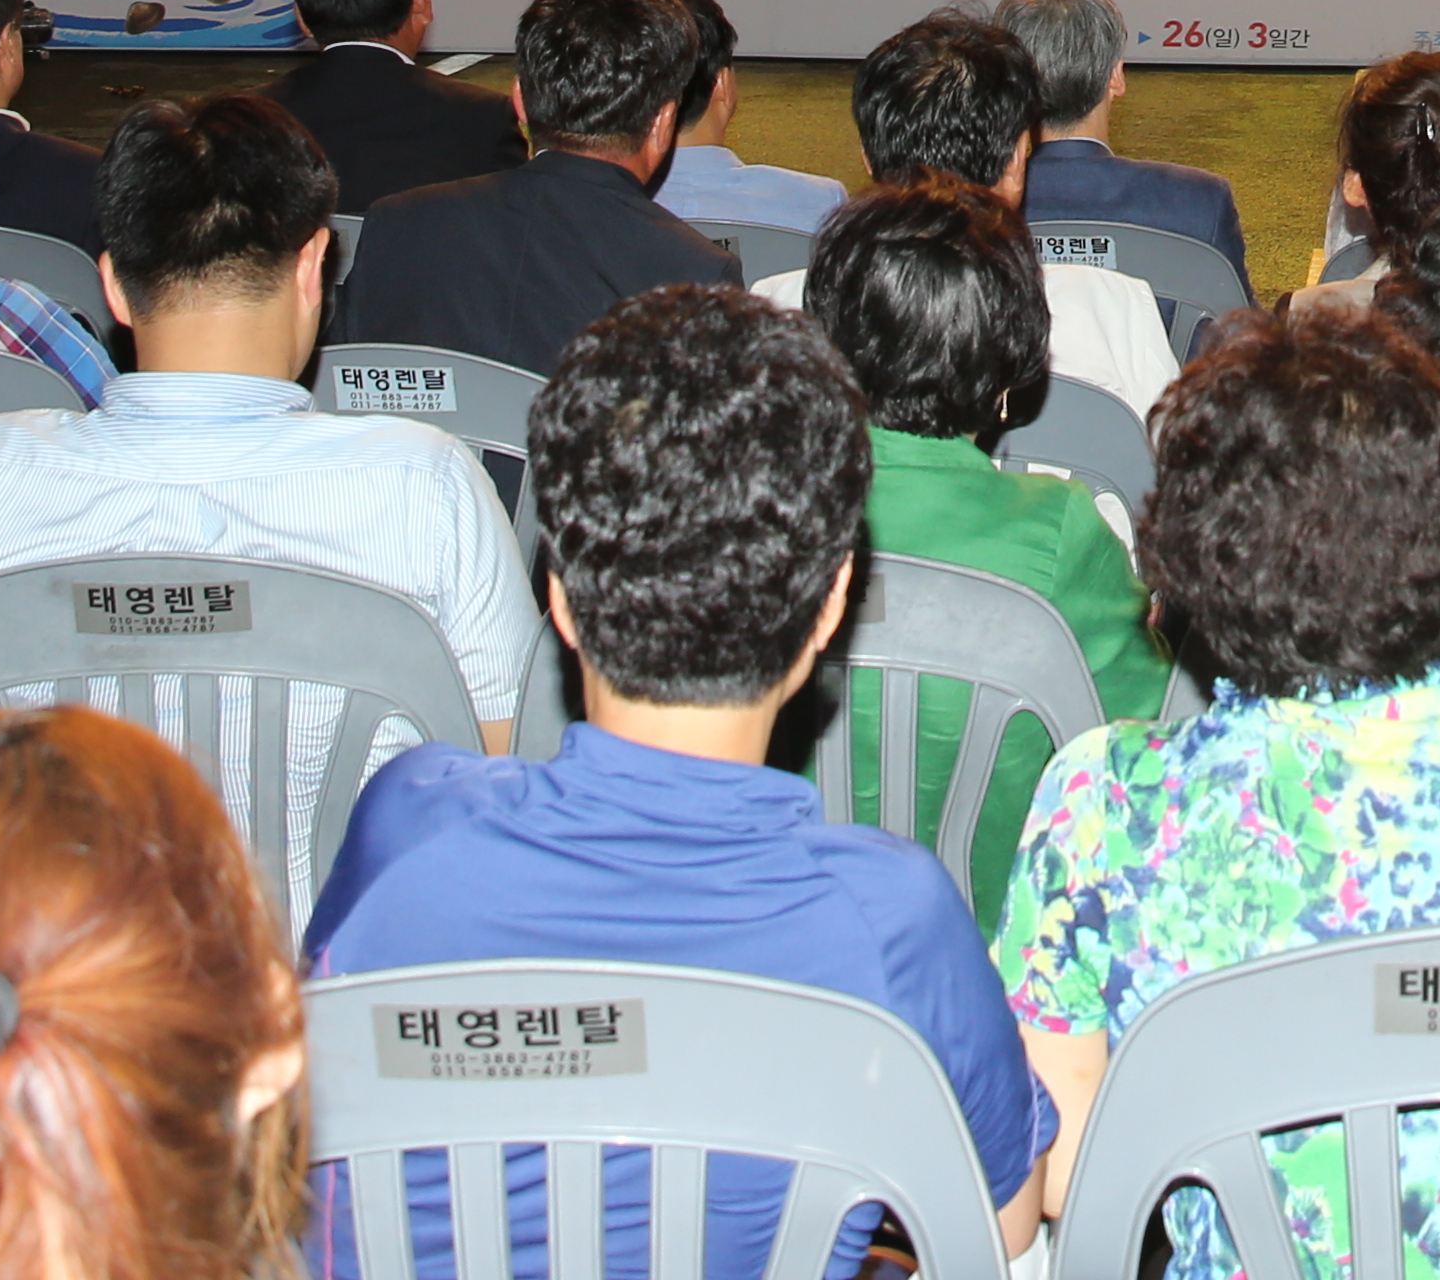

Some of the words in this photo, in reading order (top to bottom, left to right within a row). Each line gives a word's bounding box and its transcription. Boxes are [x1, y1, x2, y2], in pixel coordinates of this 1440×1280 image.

[1247, 20, 1310, 49] 3일간
[341, 368, 447, 392] 태영렌탈
[88, 584, 235, 614] 태영렌탈
[398, 1004, 623, 1048] 태영렌탈
